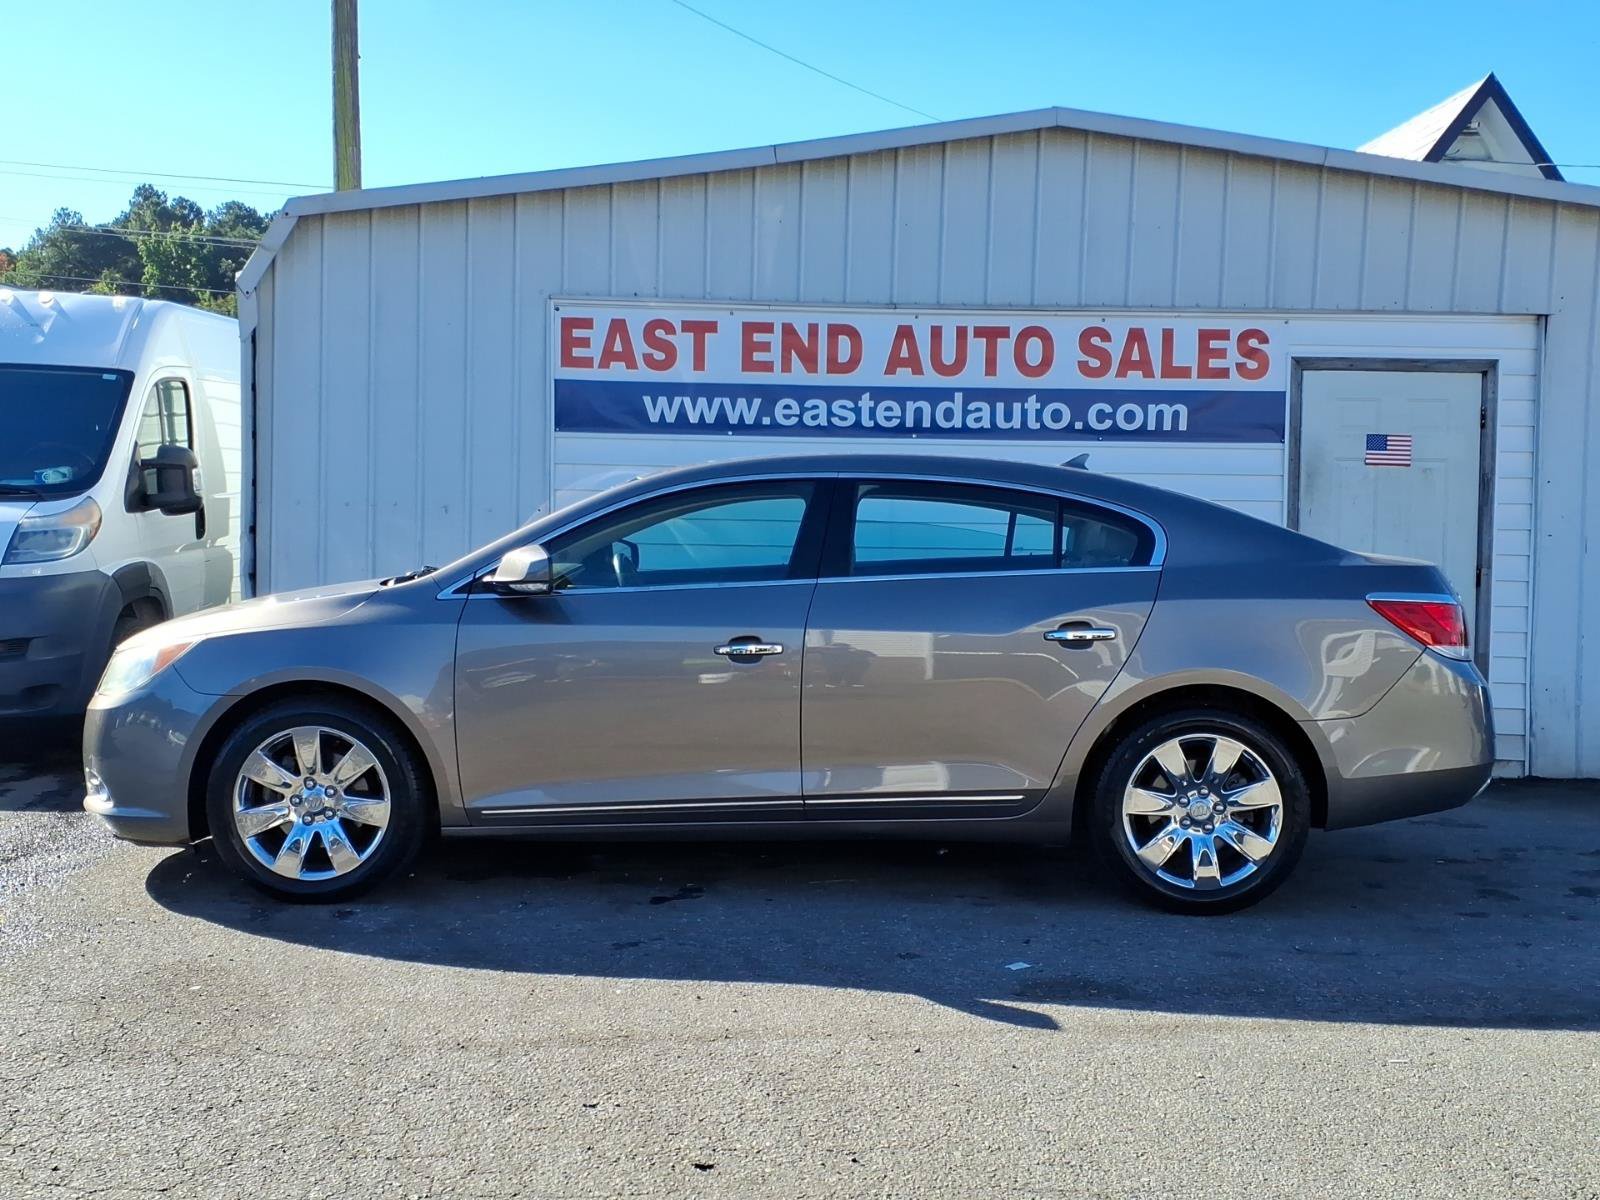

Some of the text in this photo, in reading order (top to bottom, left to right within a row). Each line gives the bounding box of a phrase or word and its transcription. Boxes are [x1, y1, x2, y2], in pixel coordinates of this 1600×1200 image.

[560, 316, 1271, 381] EAST END AUTO SALES
[642, 391, 1188, 432] www.eastendauto.com
